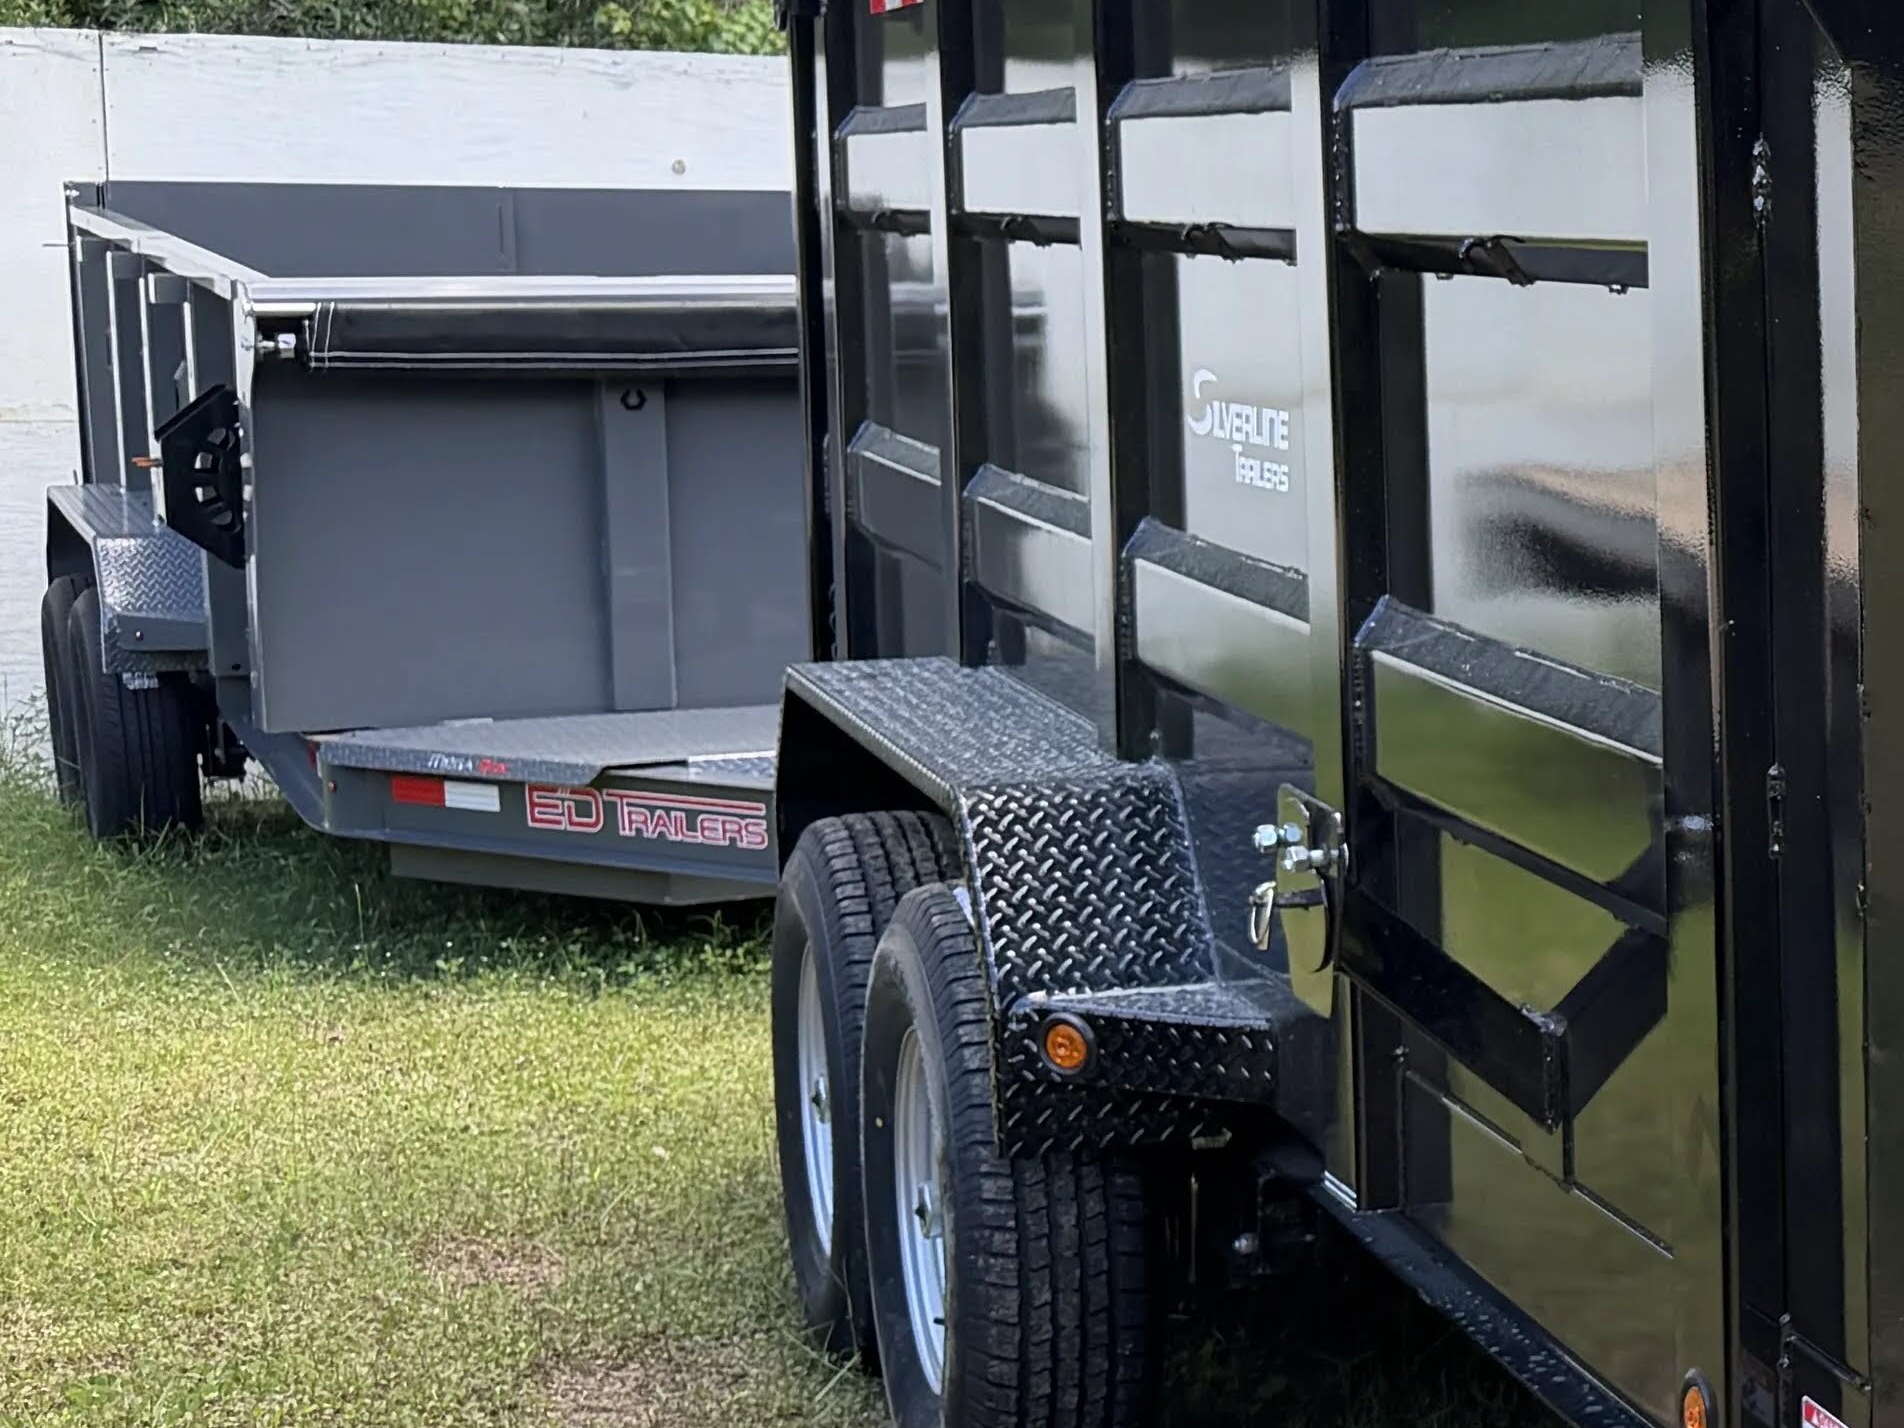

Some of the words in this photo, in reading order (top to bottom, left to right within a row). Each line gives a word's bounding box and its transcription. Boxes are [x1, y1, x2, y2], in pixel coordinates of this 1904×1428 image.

[1186, 368, 1290, 451] SILVERLINE
[1231, 443, 1289, 493] TRAILERS
[525, 783, 604, 834] ED
[604, 788, 768, 851] TRAILERS
